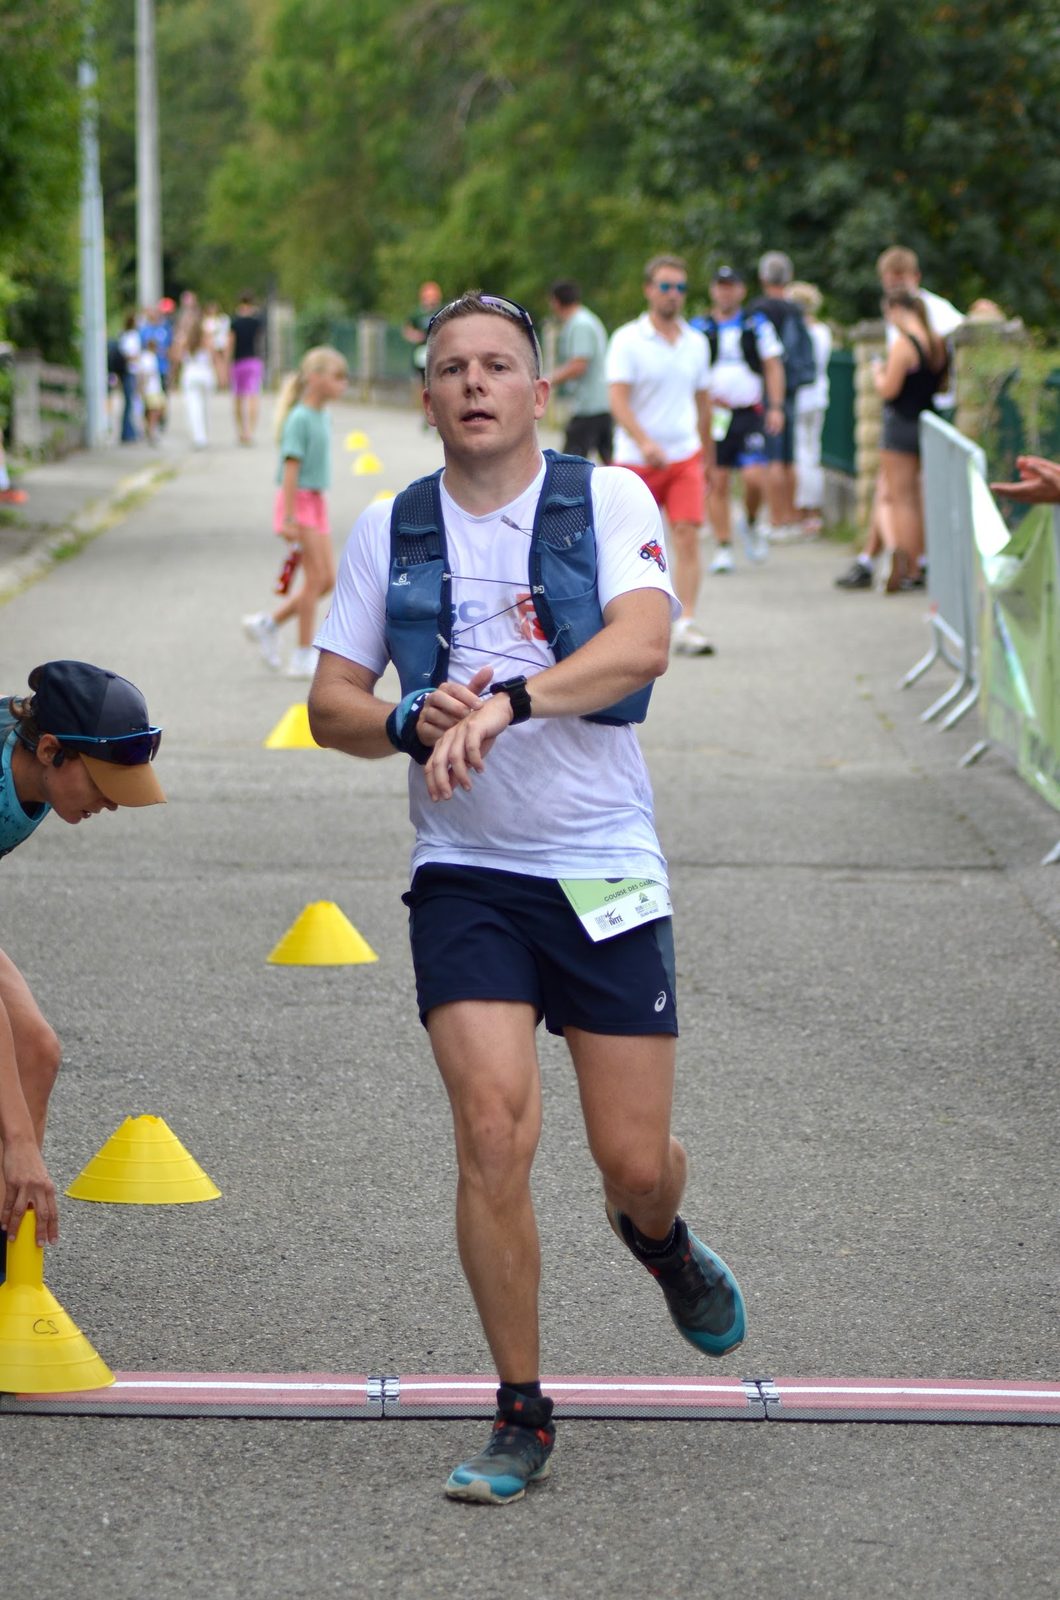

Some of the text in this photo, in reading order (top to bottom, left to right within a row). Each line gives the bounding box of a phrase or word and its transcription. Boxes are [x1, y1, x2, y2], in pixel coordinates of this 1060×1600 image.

[604, 889, 627, 902] COURSE
[627, 884, 638, 892] DES
[33, 1319, 59, 1334] CS
